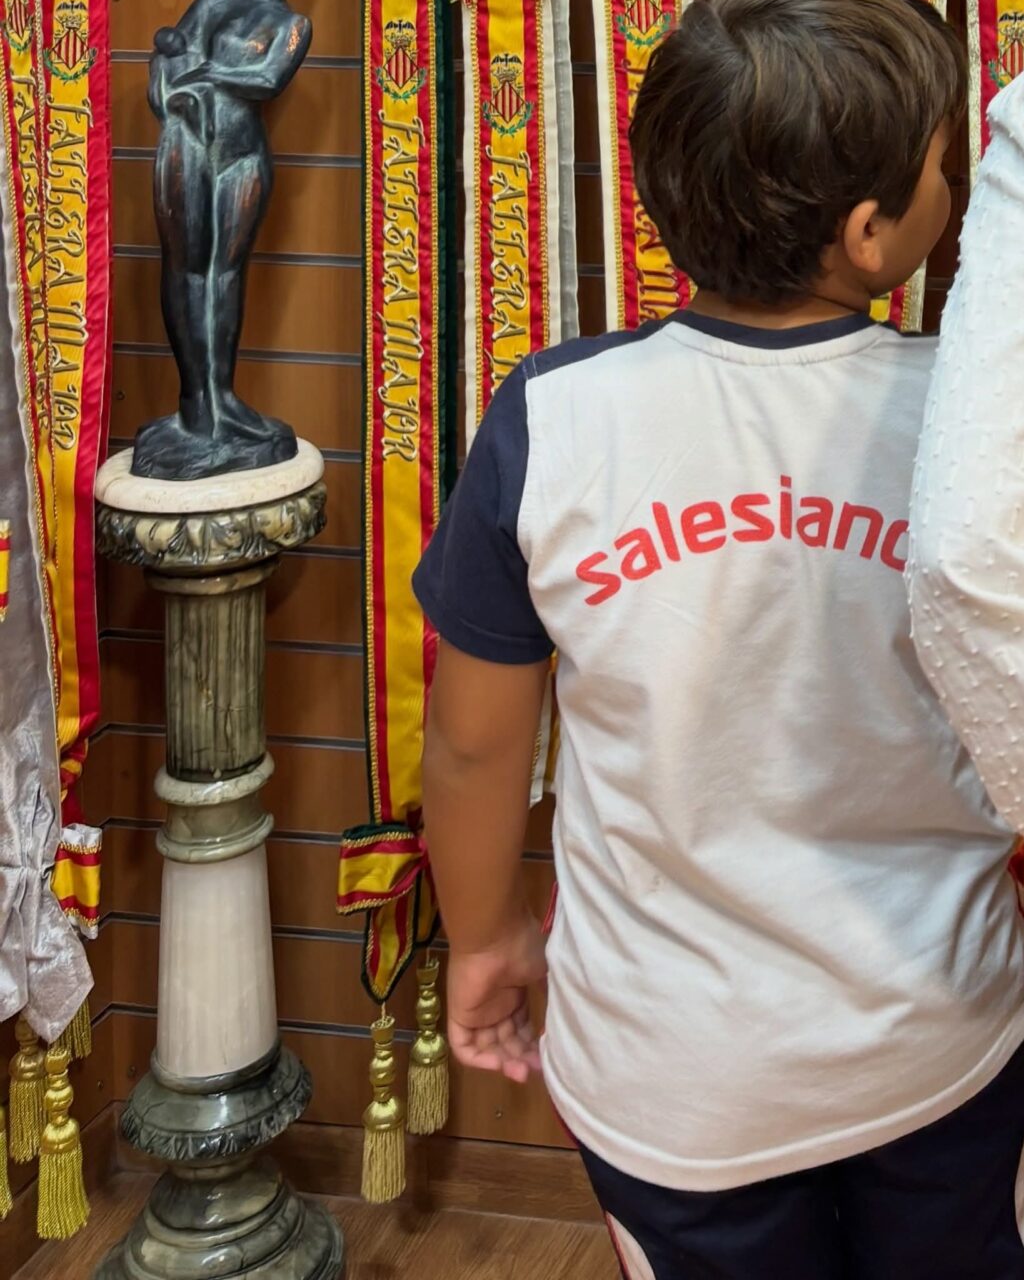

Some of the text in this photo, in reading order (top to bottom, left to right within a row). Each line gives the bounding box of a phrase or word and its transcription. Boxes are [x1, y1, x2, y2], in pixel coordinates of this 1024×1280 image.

[46, 93, 93, 289] FALLERA
[376, 109, 425, 462] FALLERA MAJOR
[485, 144, 533, 341] FALLERA
